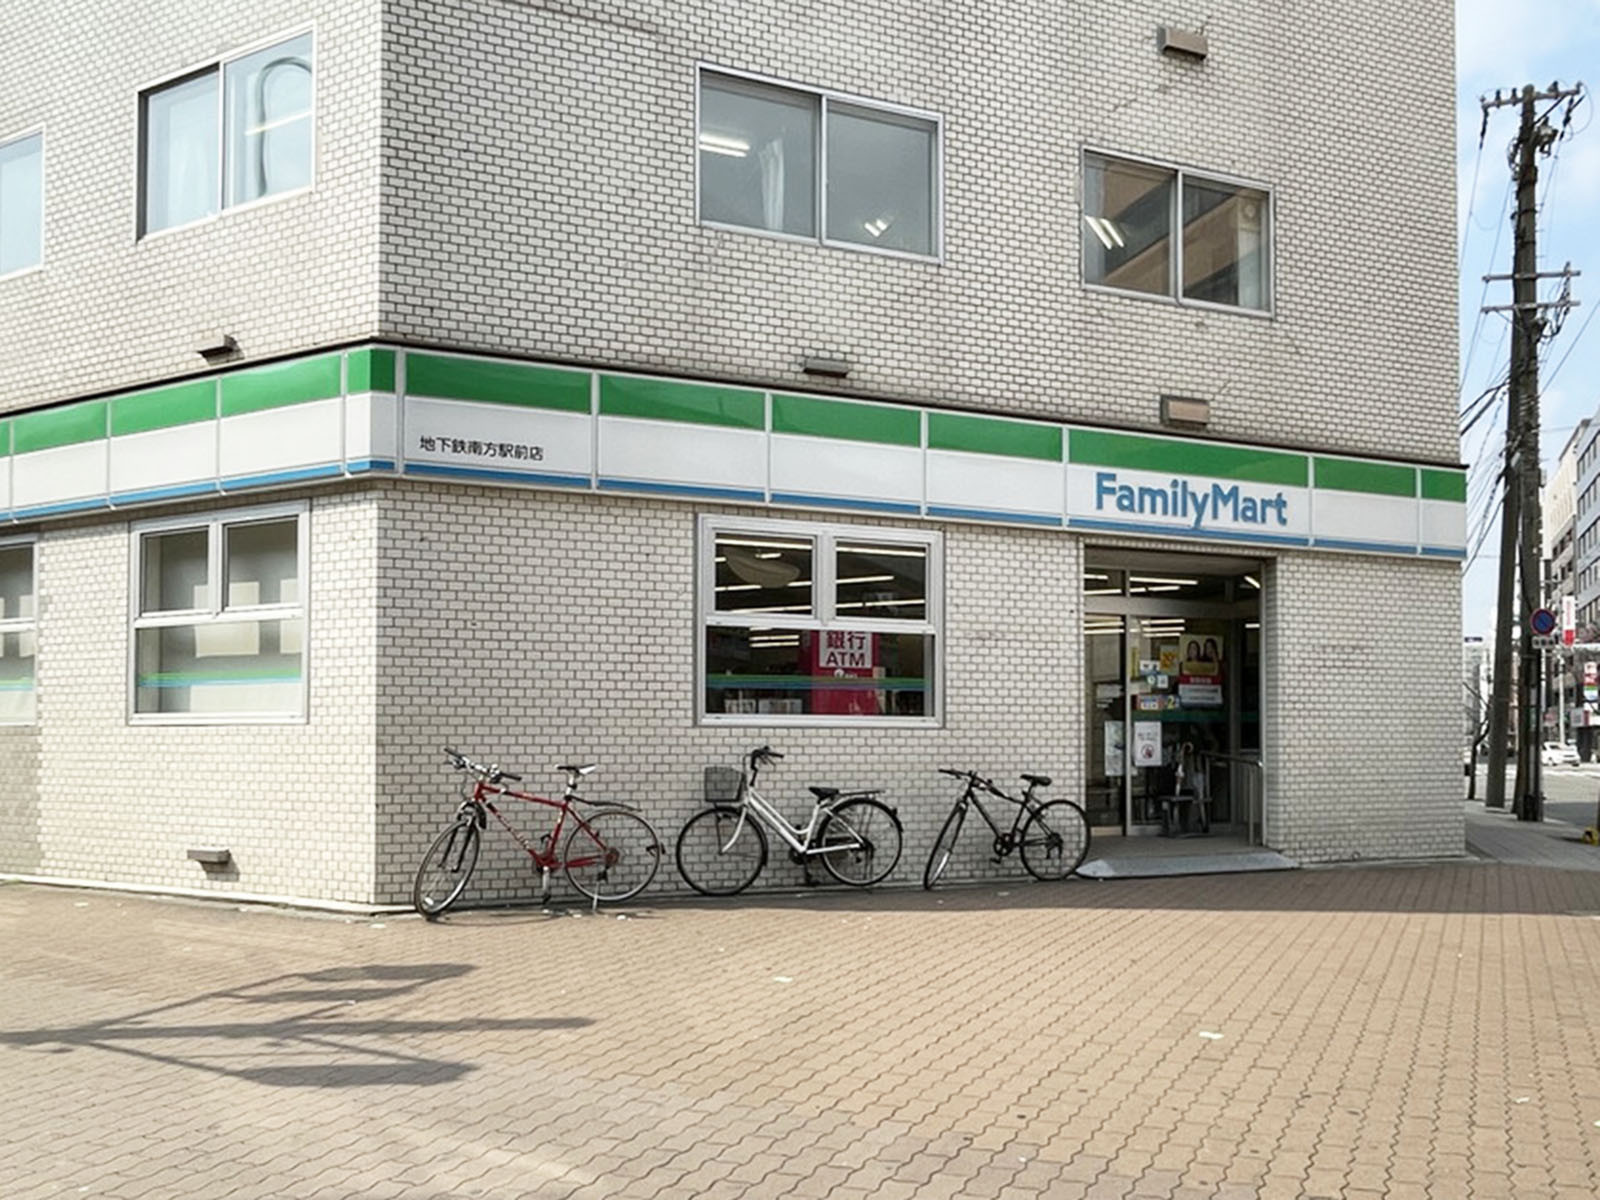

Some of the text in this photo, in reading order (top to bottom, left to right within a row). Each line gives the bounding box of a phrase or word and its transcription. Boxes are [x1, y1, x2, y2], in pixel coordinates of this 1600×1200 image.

[420, 435, 544, 461] 地下鉄南方駅前店
[1096, 472, 1287, 529] FamilyMart
[826, 631, 866, 650] 銀行
[826, 651, 866, 666] ATM
